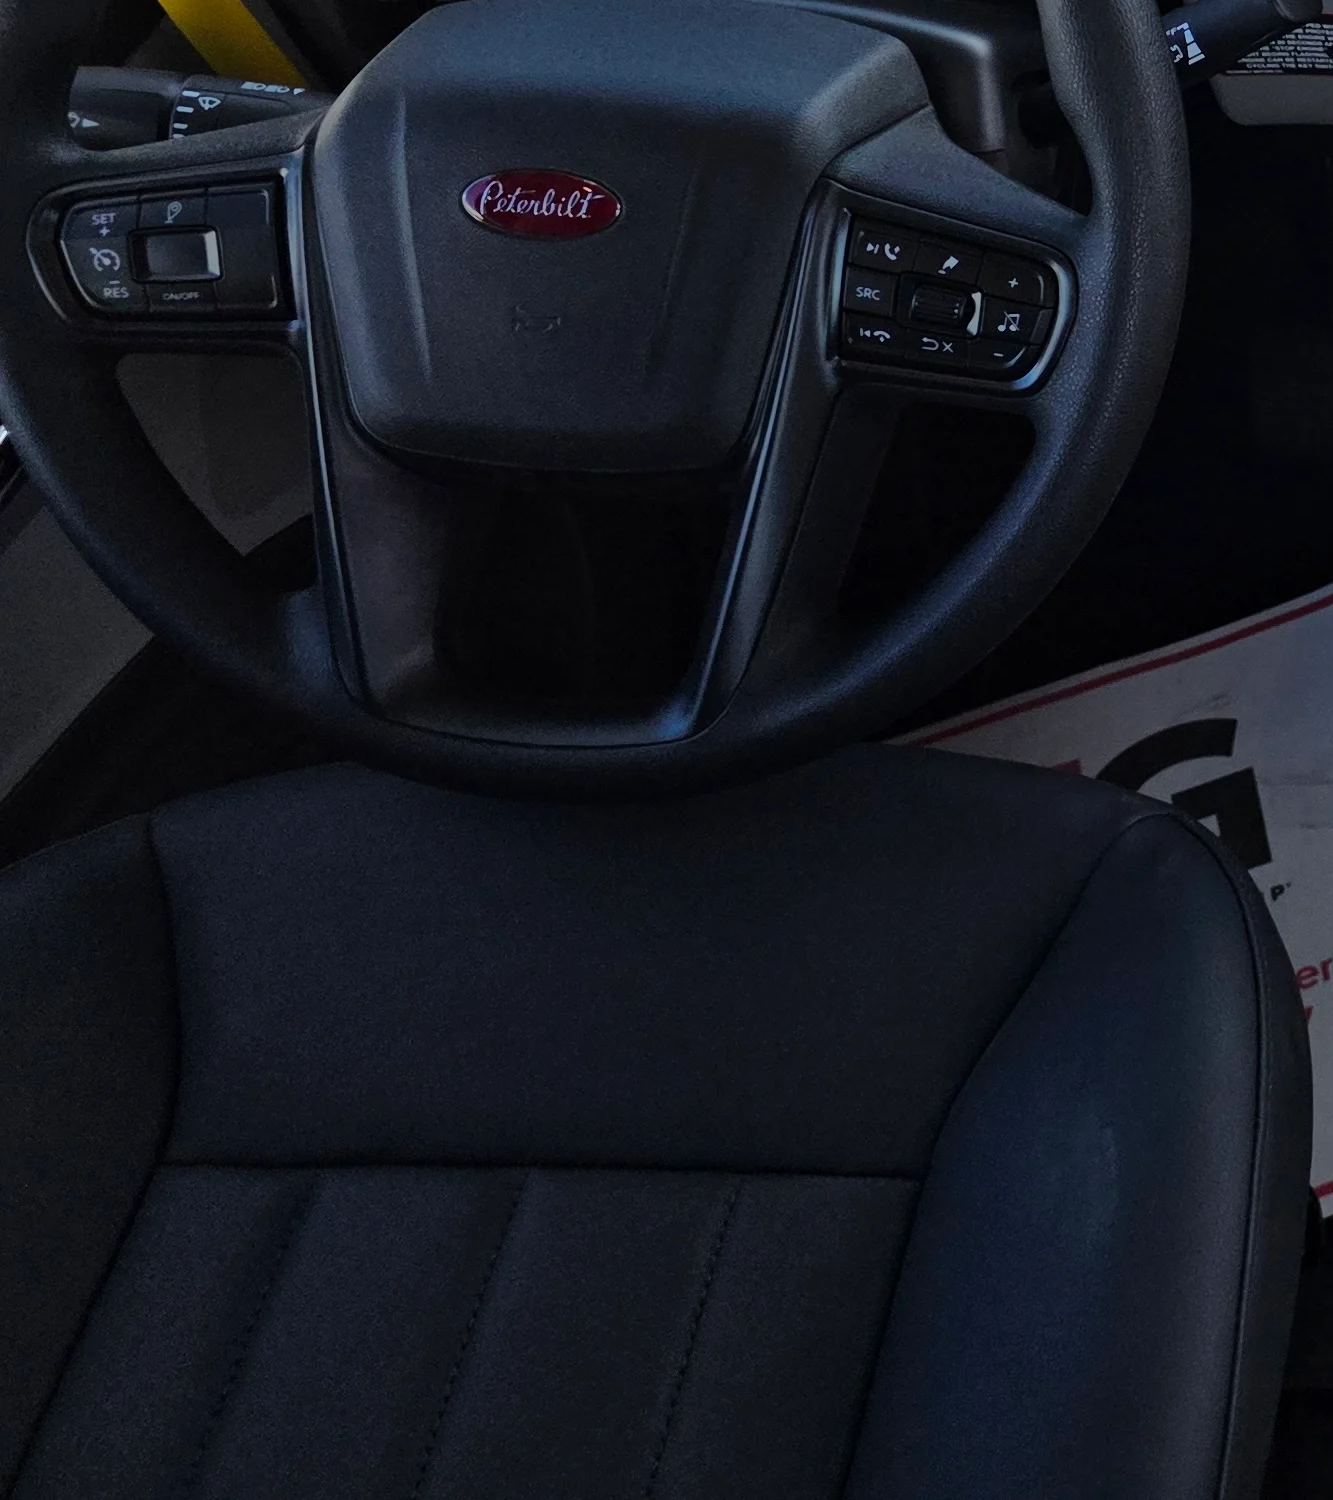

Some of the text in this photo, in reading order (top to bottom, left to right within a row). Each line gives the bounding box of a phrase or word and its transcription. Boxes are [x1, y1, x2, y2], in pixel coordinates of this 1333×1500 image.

[480, 180, 605, 218] Peterbilt
[91, 212, 117, 225] SET
[103, 287, 130, 299] RES
[856, 286, 881, 301] SRC
